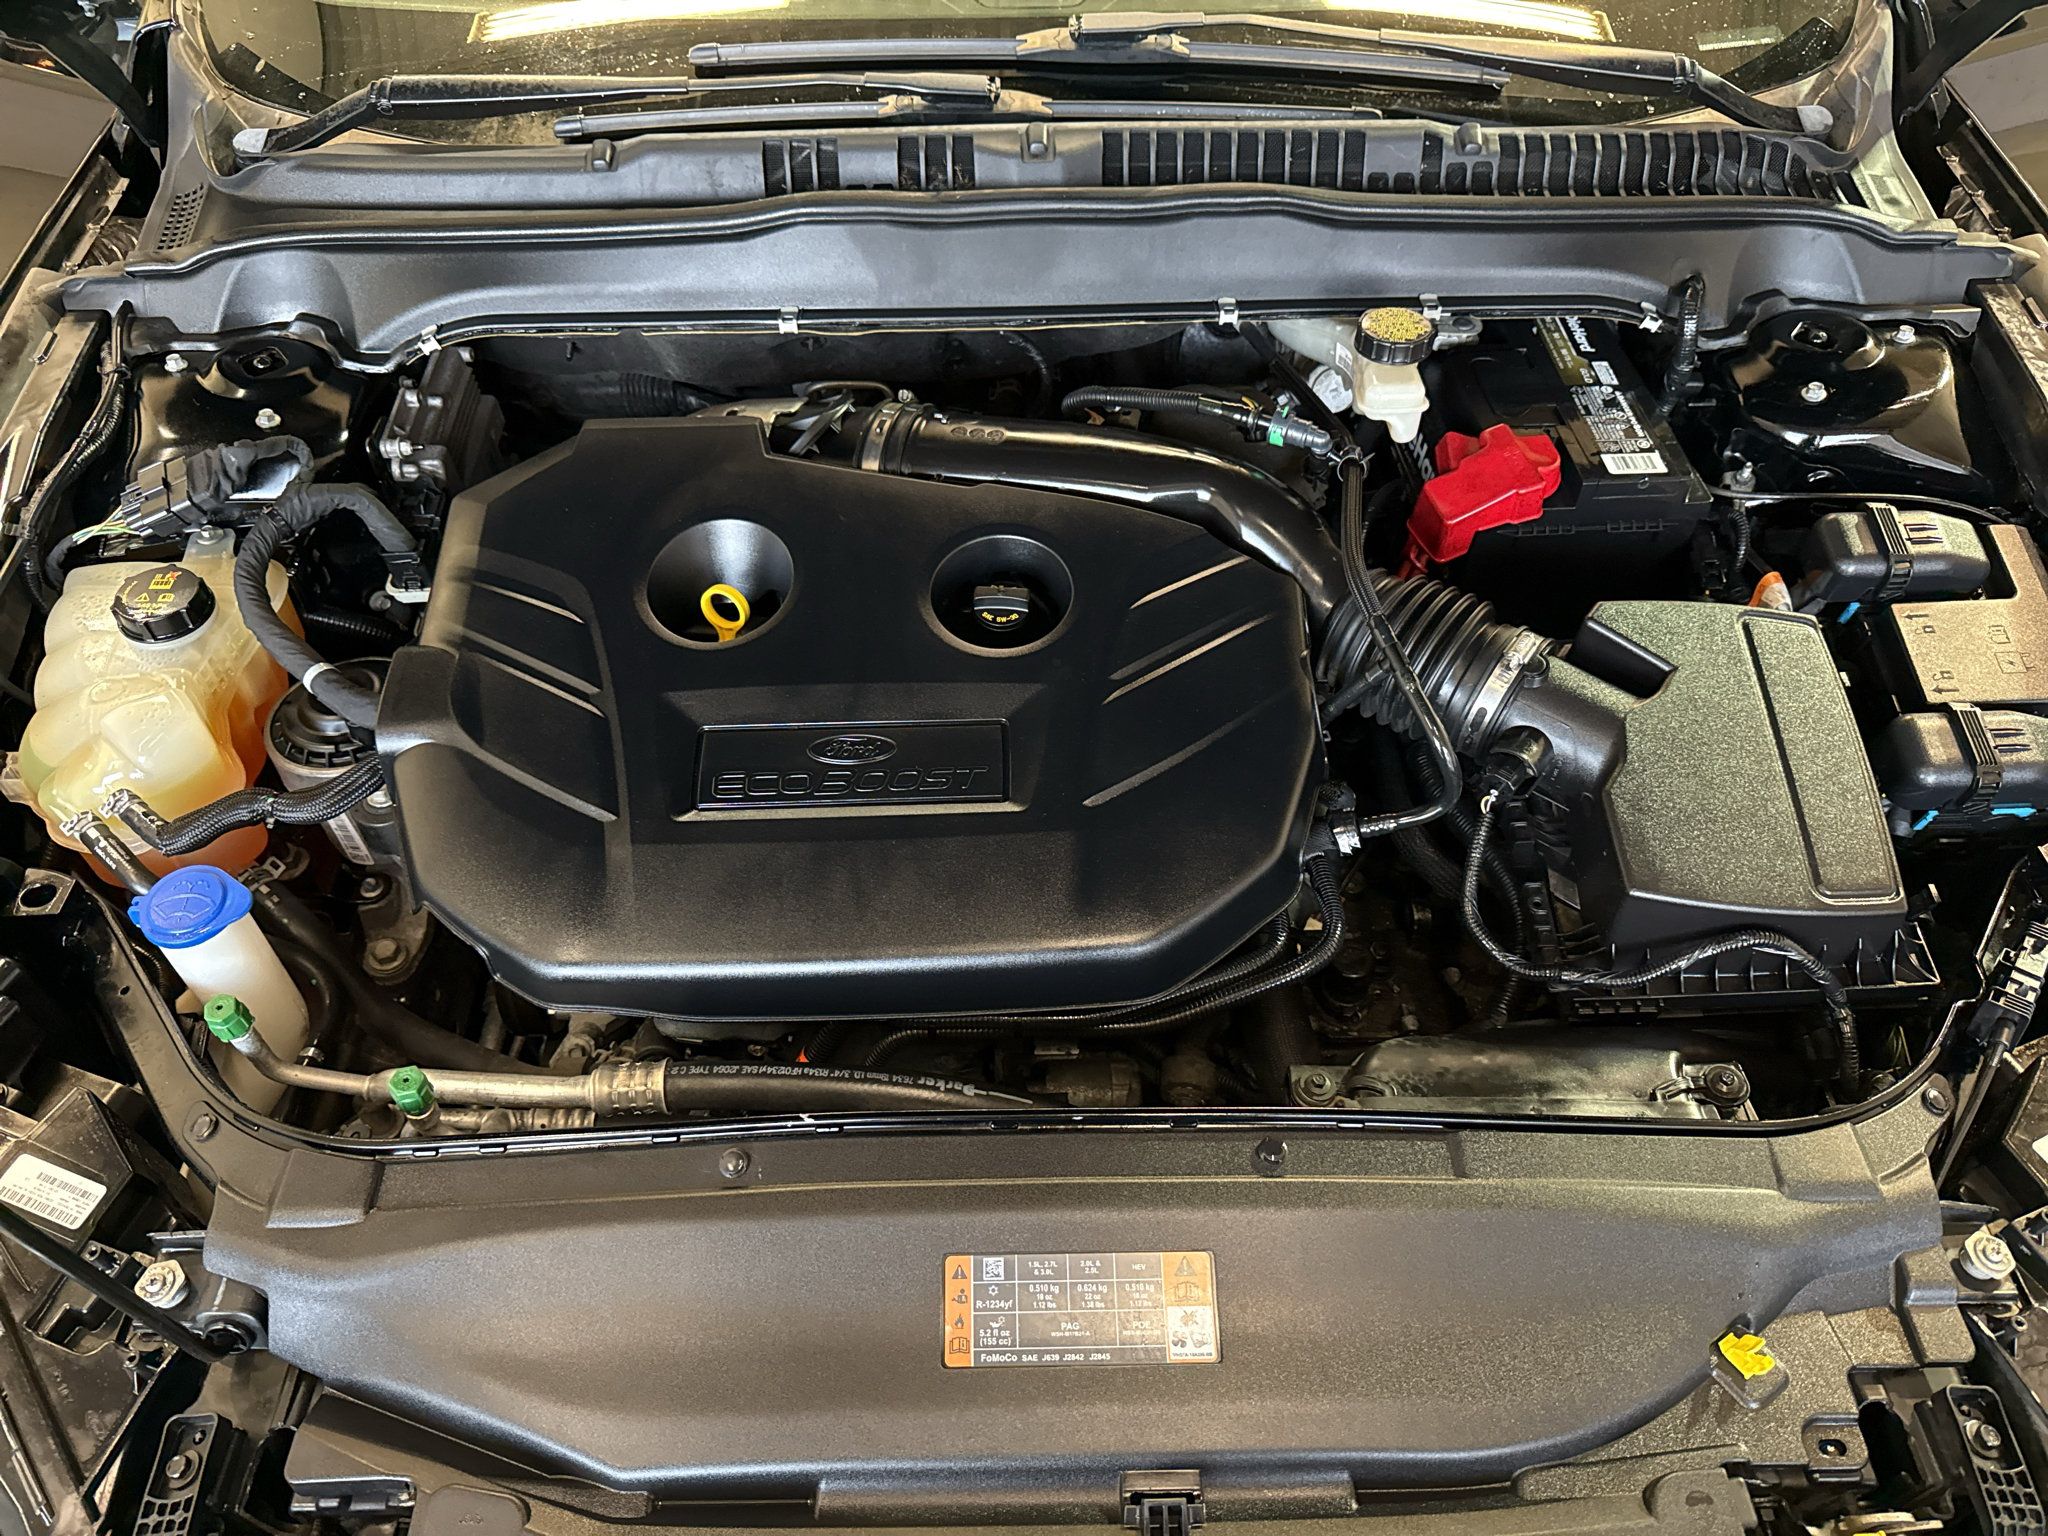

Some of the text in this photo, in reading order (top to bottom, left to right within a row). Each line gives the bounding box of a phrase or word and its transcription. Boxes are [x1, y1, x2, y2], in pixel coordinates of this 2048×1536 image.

[1579, 367, 1594, 384] GOLD
[982, 612, 994, 621] SAE
[711, 765, 990, 799] ECOBOOST
[688, 1066, 710, 1074] TYPE
[741, 1065, 759, 1074] SAE
[804, 1068, 830, 1077] R134a
[892, 1074, 914, 1084] 7634
[918, 1076, 975, 1096] Parker
[1029, 1284, 1060, 1294] 0.510 kg
[1077, 1284, 1107, 1293] 0.624 kg
[1145, 1283, 1154, 1292] kg
[976, 1300, 1013, 1310] R-1234yf
[1061, 1322, 1080, 1330] PAG
[980, 1337, 1011, 1347] (155 cc)
[980, 1353, 1018, 1362] FoMoCo
